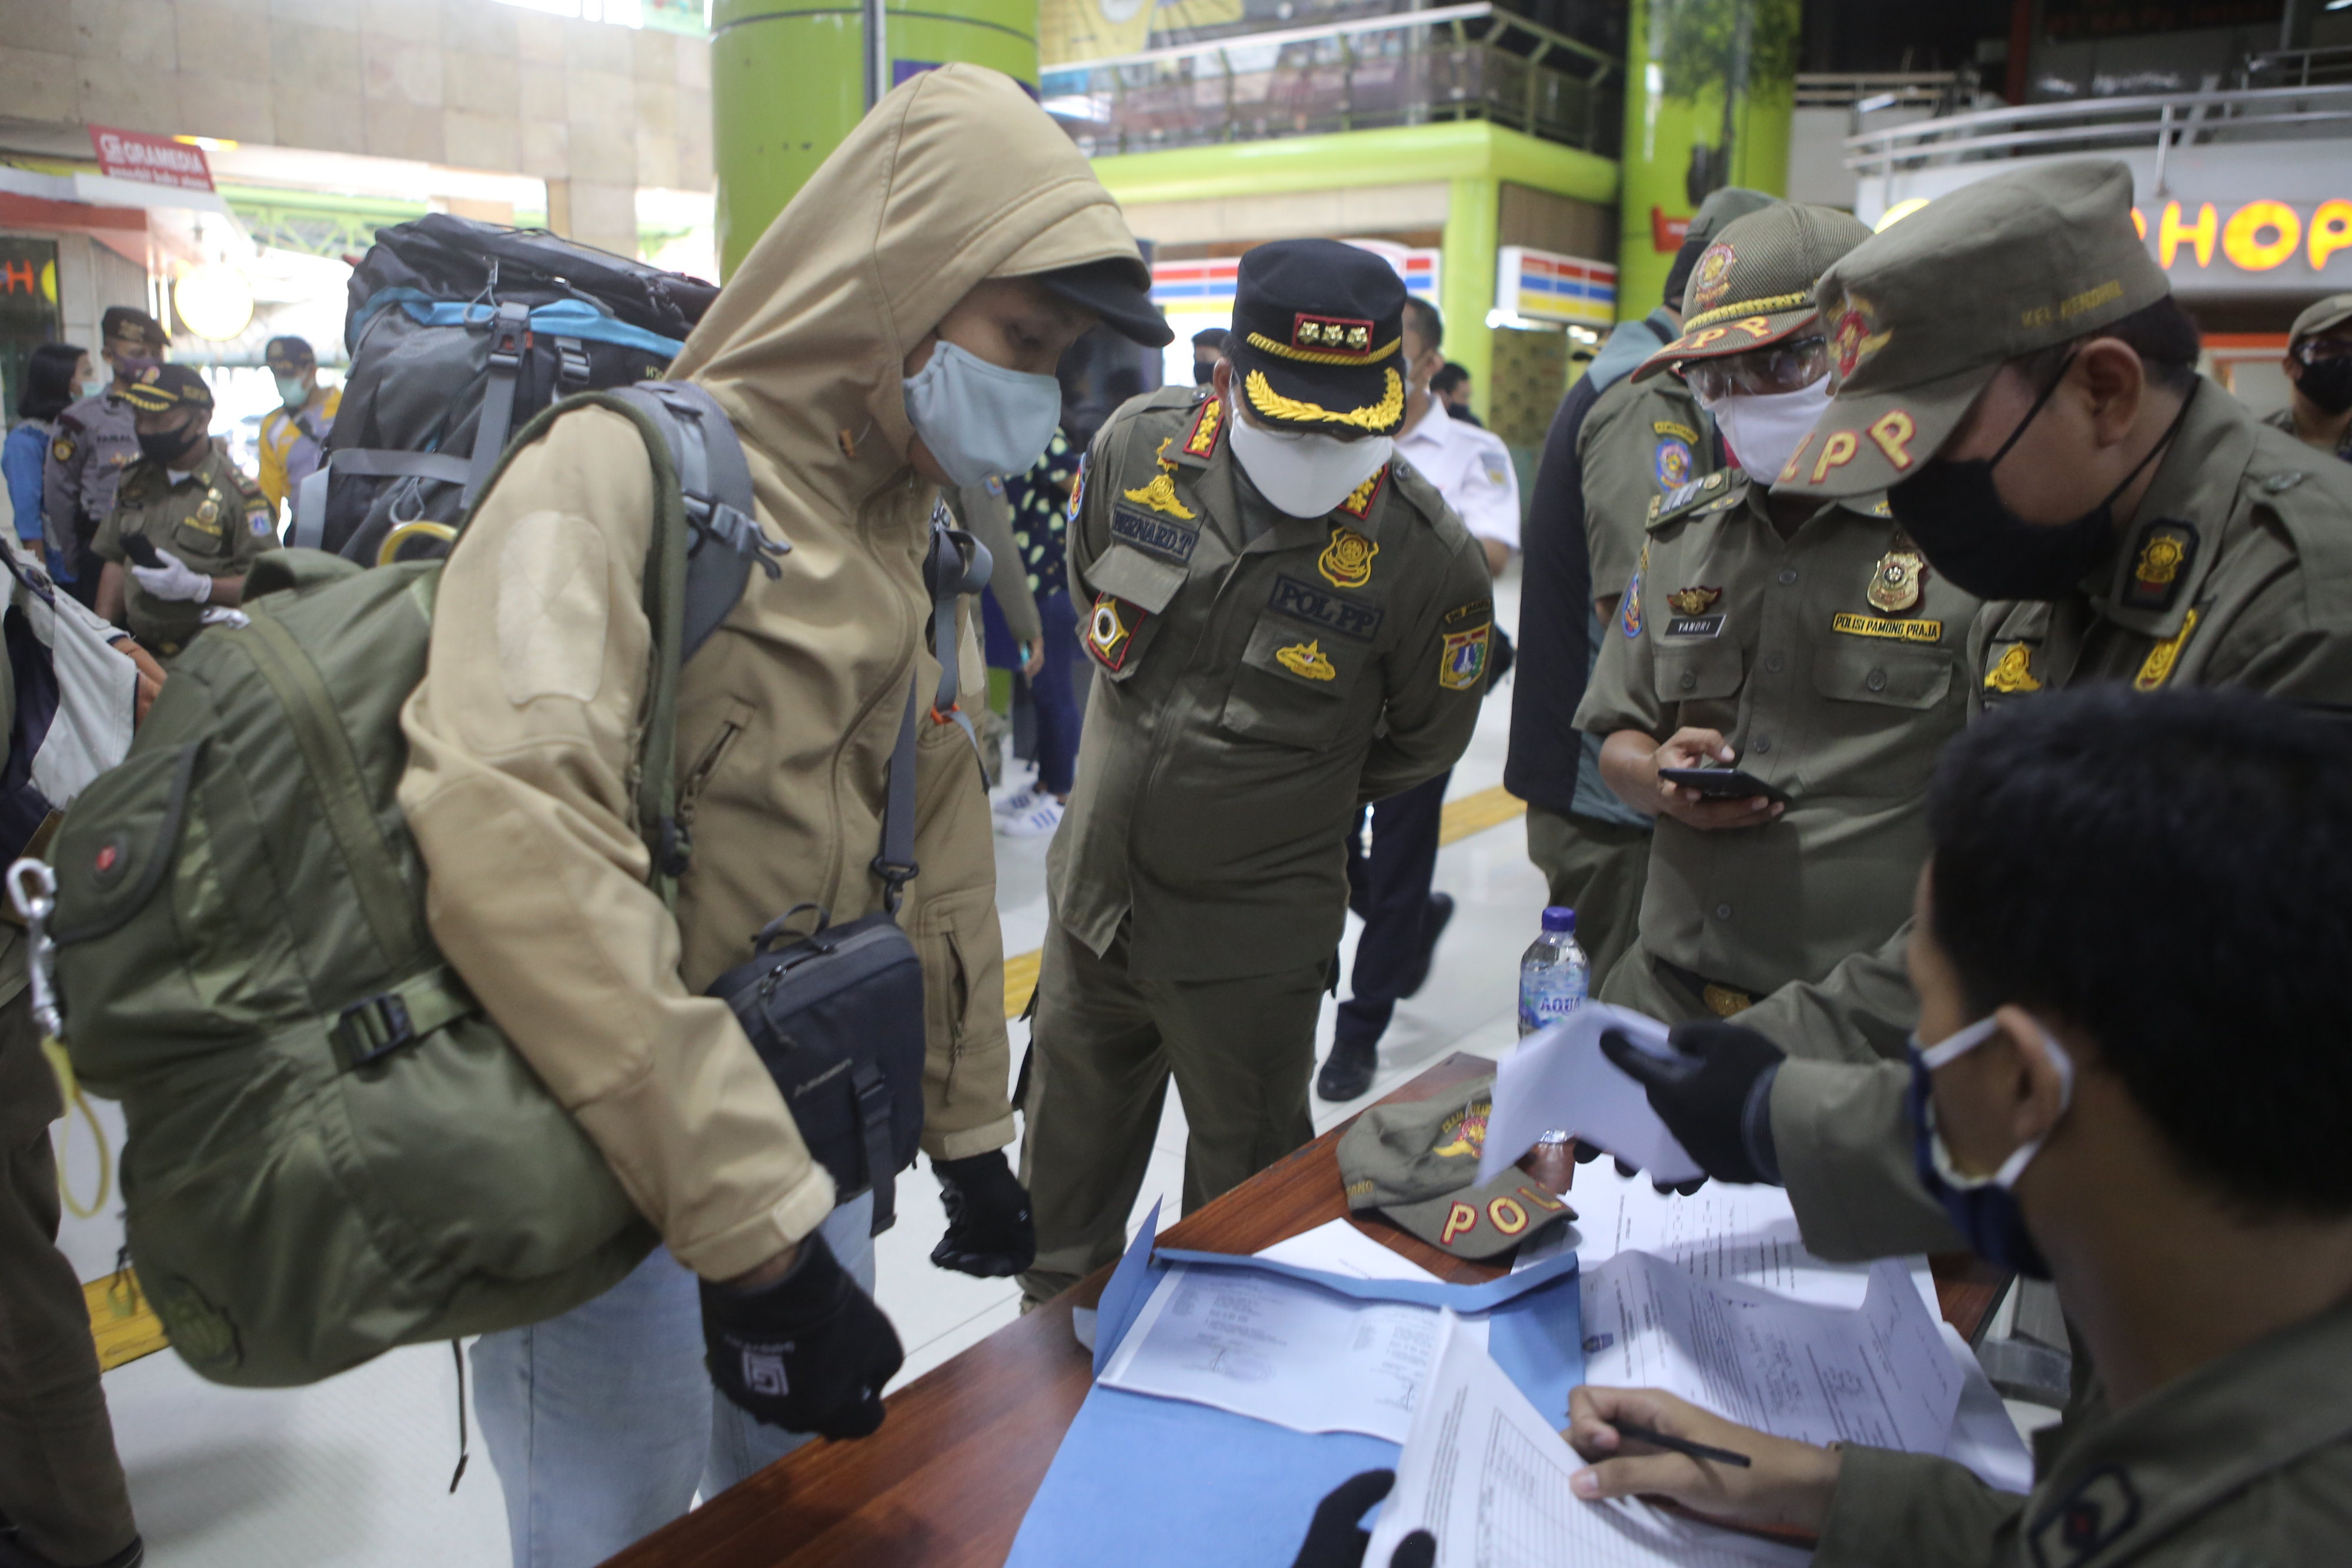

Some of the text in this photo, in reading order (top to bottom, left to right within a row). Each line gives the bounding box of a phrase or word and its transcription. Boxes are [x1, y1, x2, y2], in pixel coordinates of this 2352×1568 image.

[123, 141, 205, 175] GRAMEDIA
[2131, 198, 2352, 271] HOP
[1279, 582, 1375, 634] POL PP
[1835, 616, 1937, 638] POLISI PAMONG PRAJA
[1441, 1185, 1564, 1246] POL
